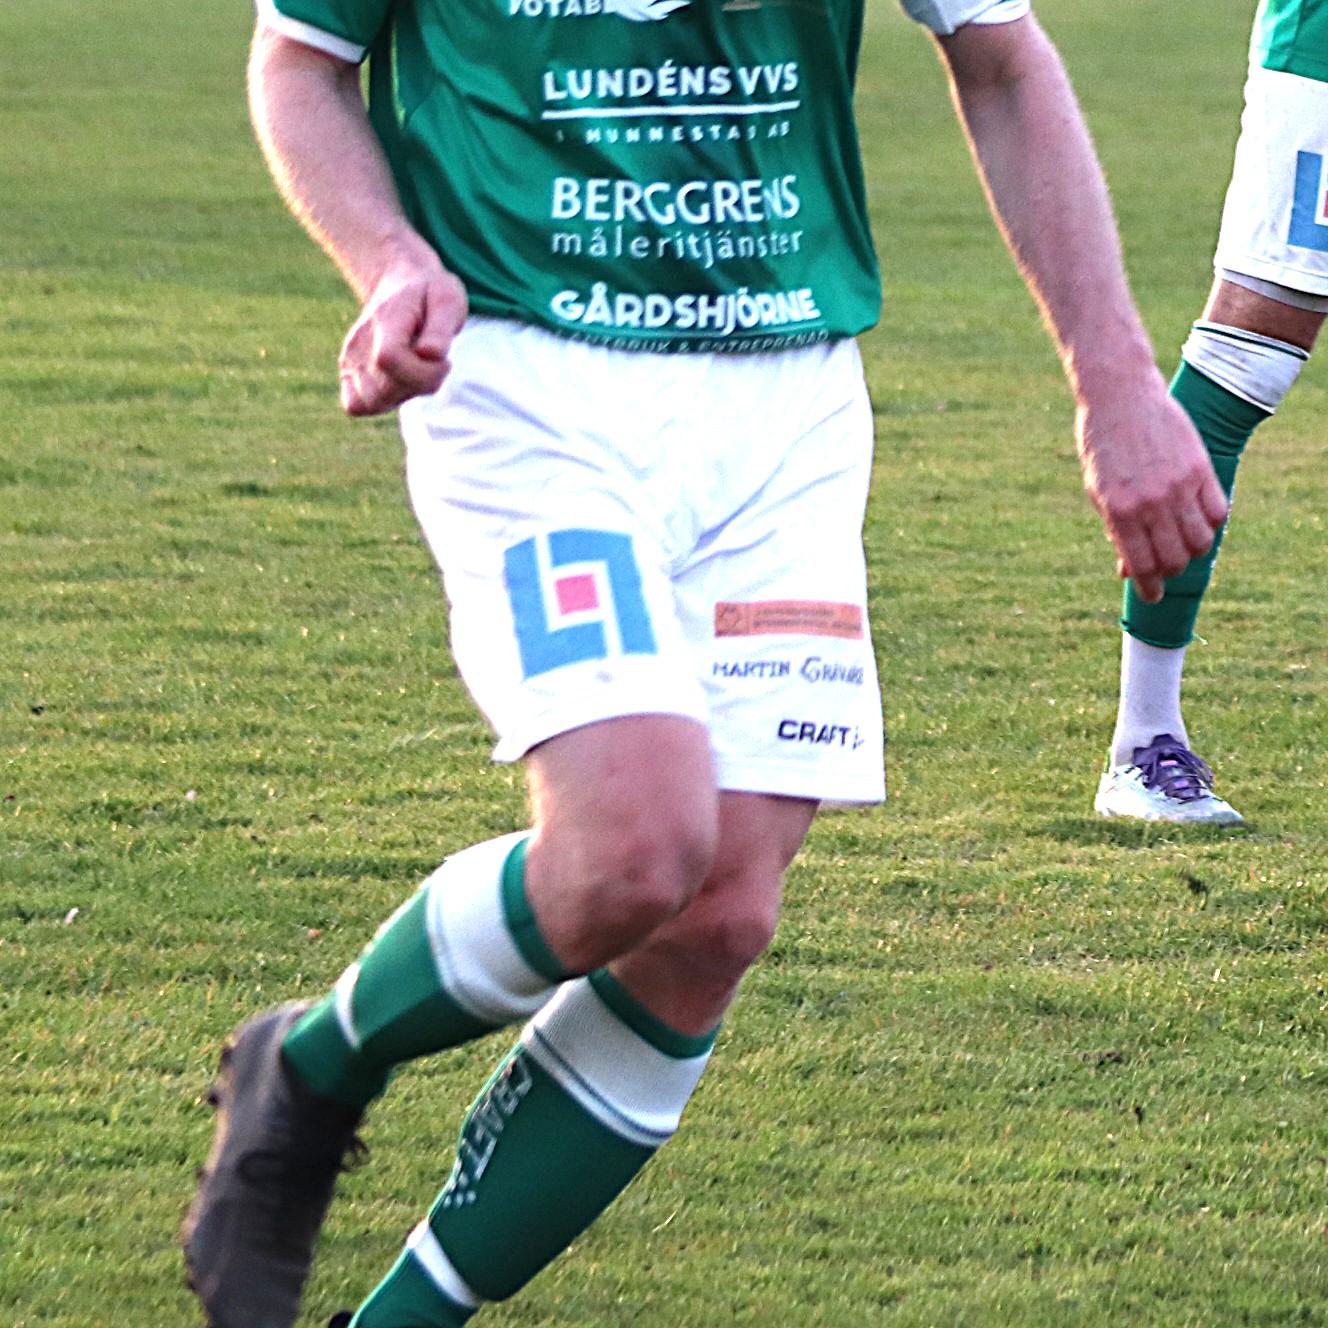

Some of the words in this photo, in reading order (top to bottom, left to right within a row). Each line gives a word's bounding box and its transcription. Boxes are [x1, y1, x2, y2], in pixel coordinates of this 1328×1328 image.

[542, 59, 732, 102] LUNDÉNS
[739, 61, 799, 96] VVS
[551, 174, 801, 225] BERGGRENS
[551, 225, 803, 270] måleritjänster
[551, 281, 822, 336] GÅRDSHJÖRNE
[713, 660, 791, 678] MARTIN
[777, 718, 851, 747] CRAFT
